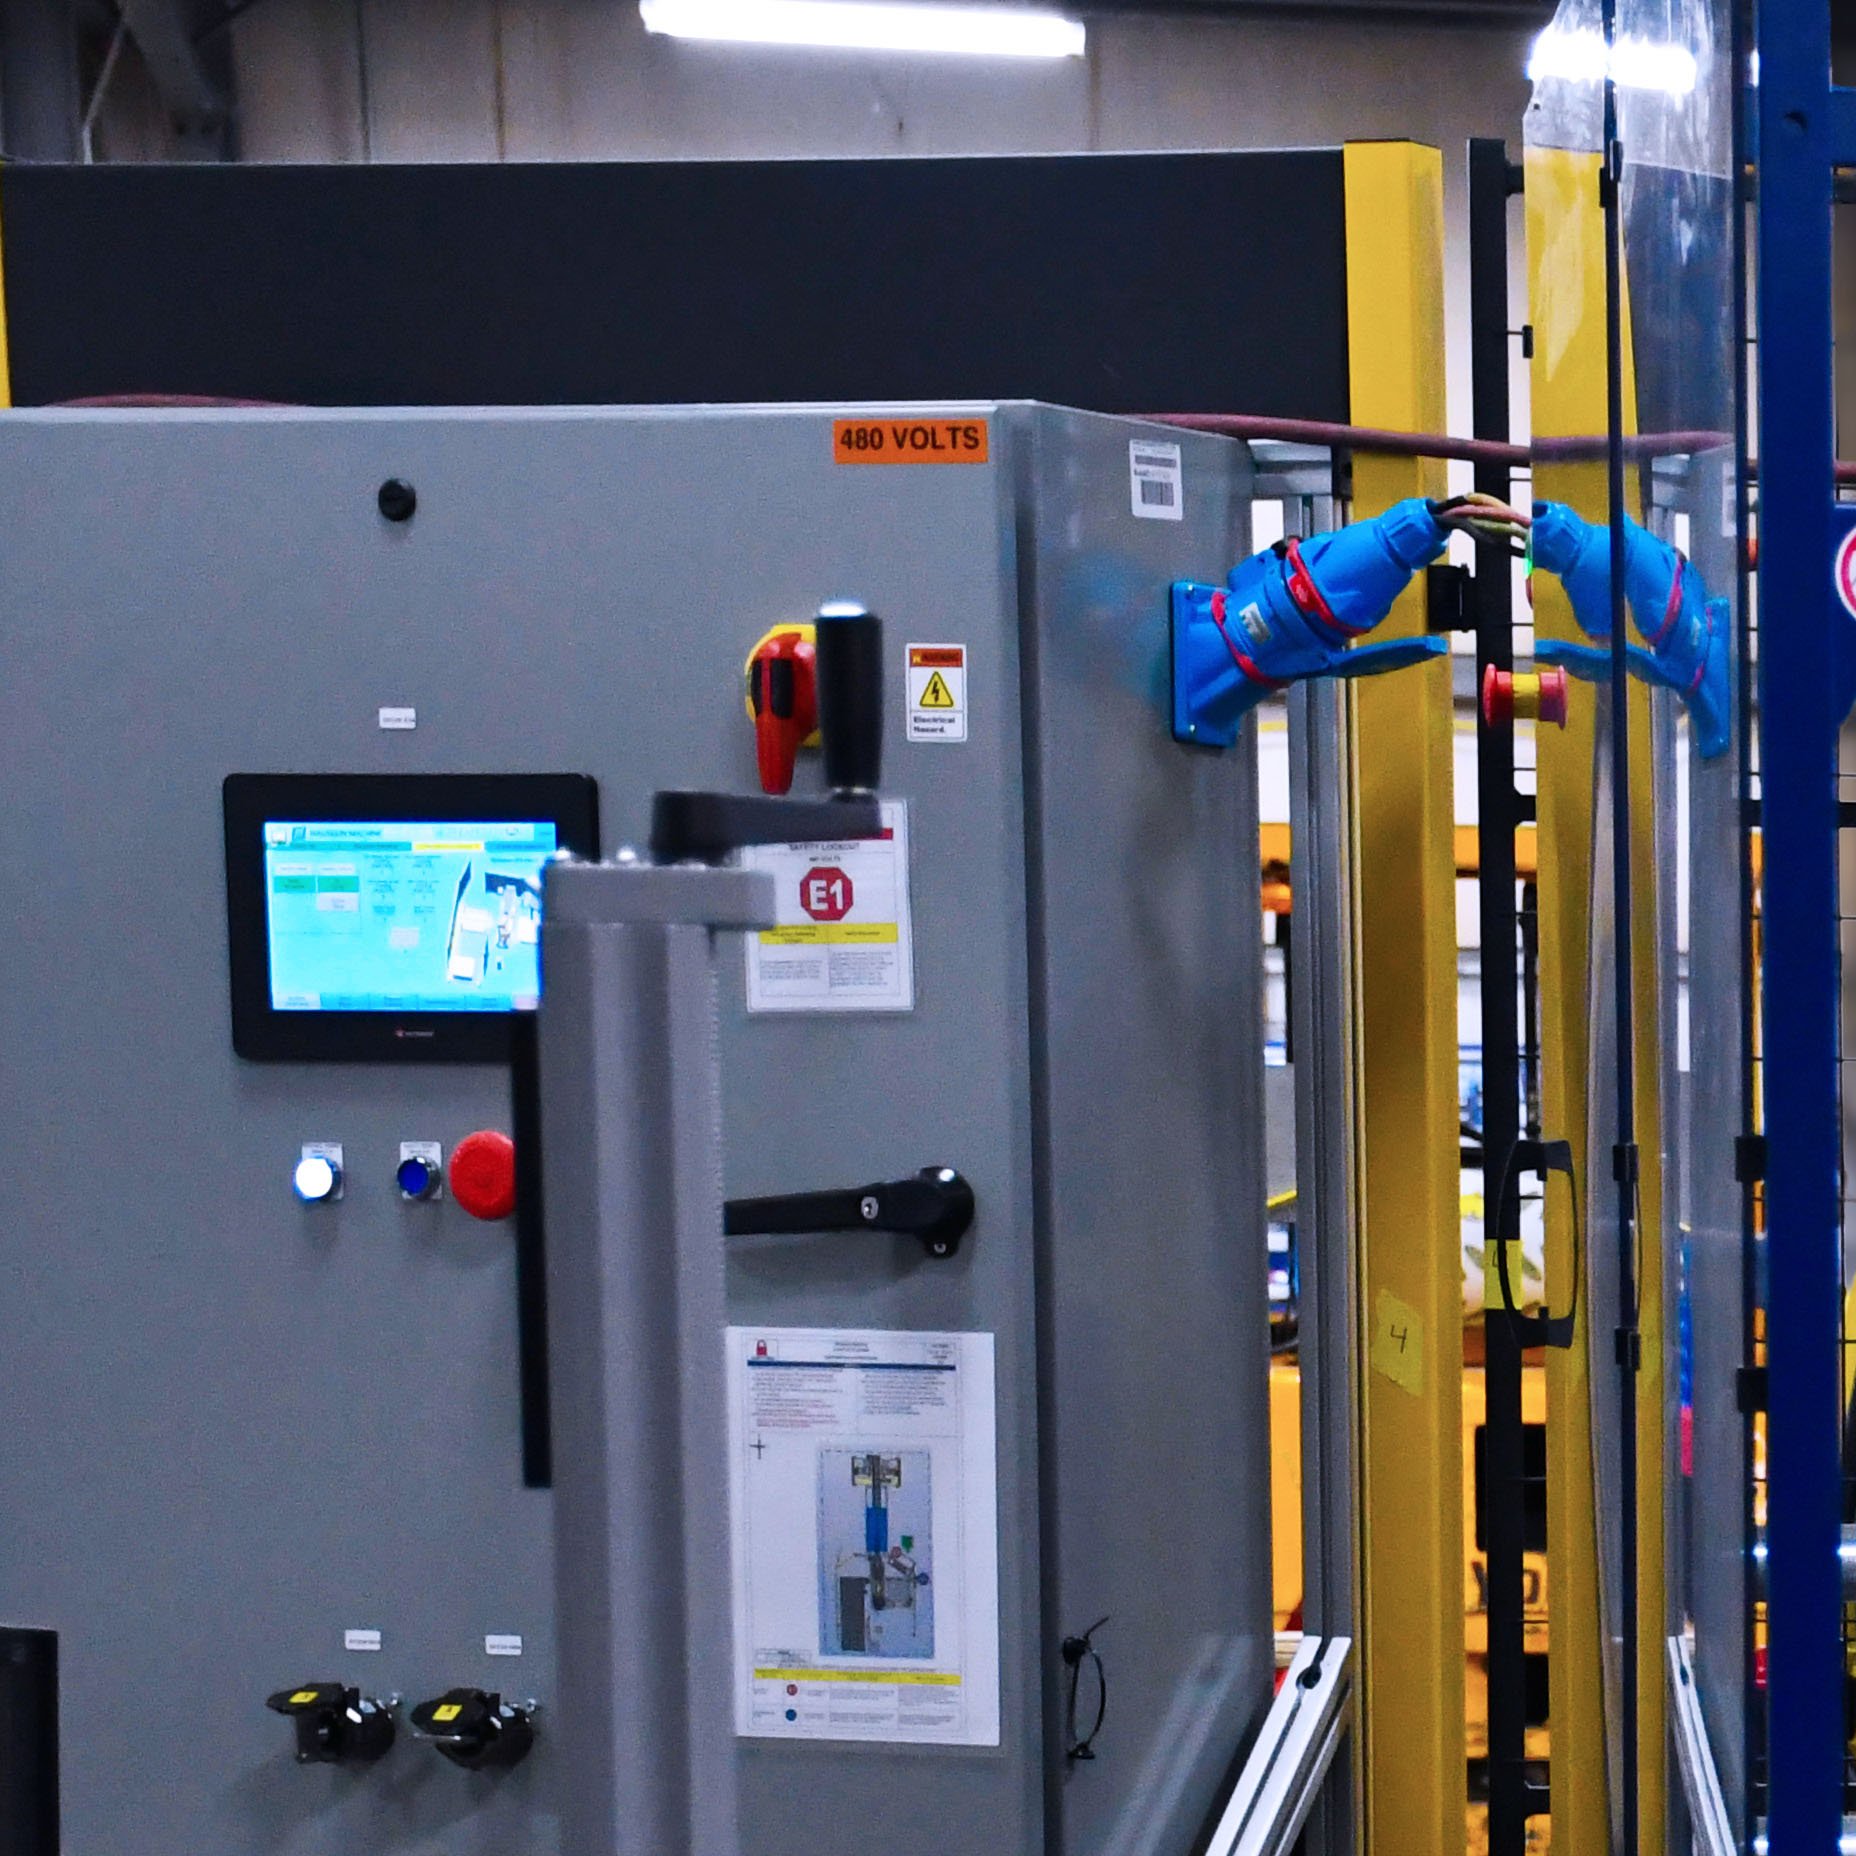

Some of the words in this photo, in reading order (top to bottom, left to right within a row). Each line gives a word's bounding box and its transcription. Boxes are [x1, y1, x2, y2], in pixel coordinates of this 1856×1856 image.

[840, 427, 884, 450] 480
[892, 425, 980, 450] VOLTS
[809, 879, 845, 911] E1
[1390, 1324, 1407, 1354] 4
